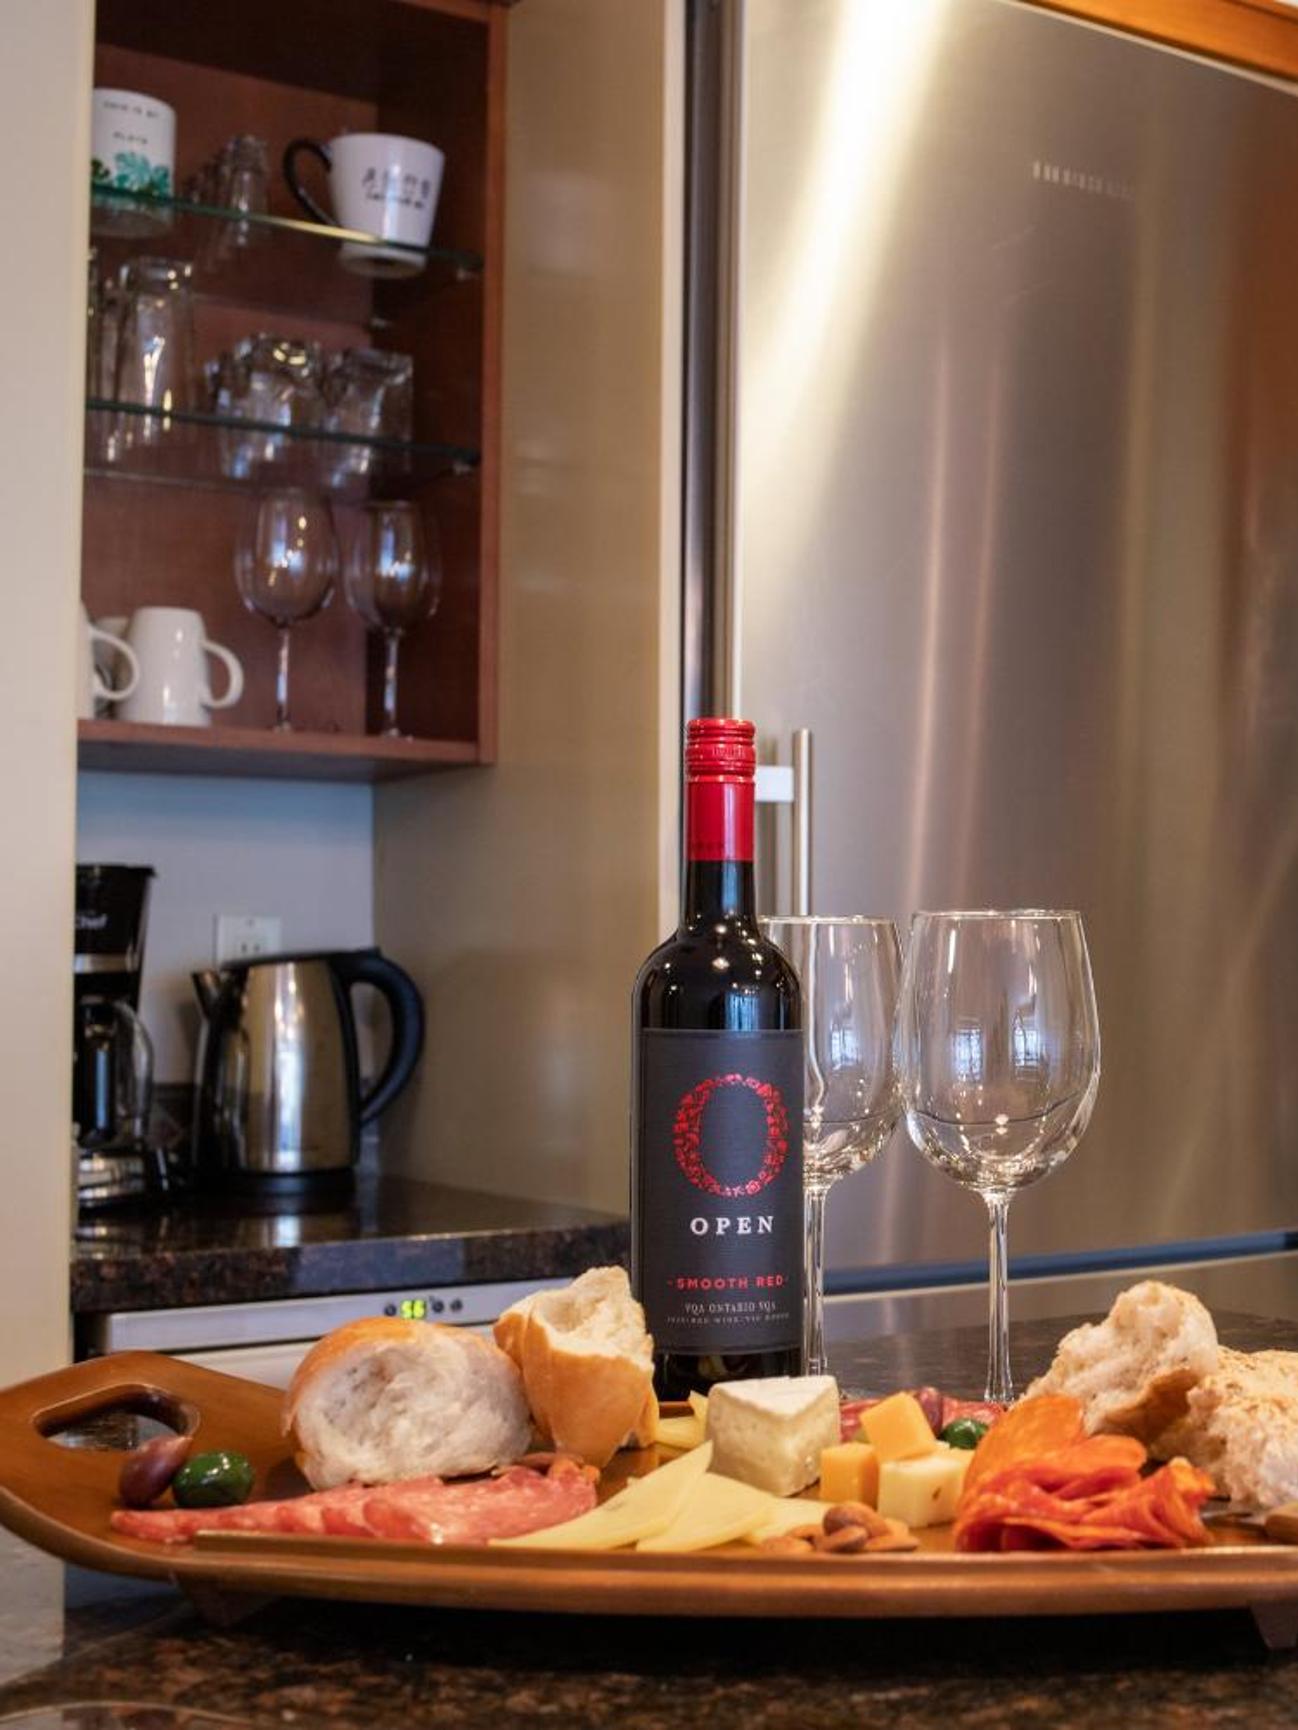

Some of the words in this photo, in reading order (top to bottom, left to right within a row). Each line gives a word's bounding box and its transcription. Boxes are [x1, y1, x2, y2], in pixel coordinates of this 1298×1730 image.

[690, 1216, 774, 1236] OPEN
[677, 1278, 749, 1291] SMOOTH
[755, 1275, 784, 1288] RED
[686, 1304, 706, 1316] VQA
[708, 1303, 756, 1314] ONTARIO
